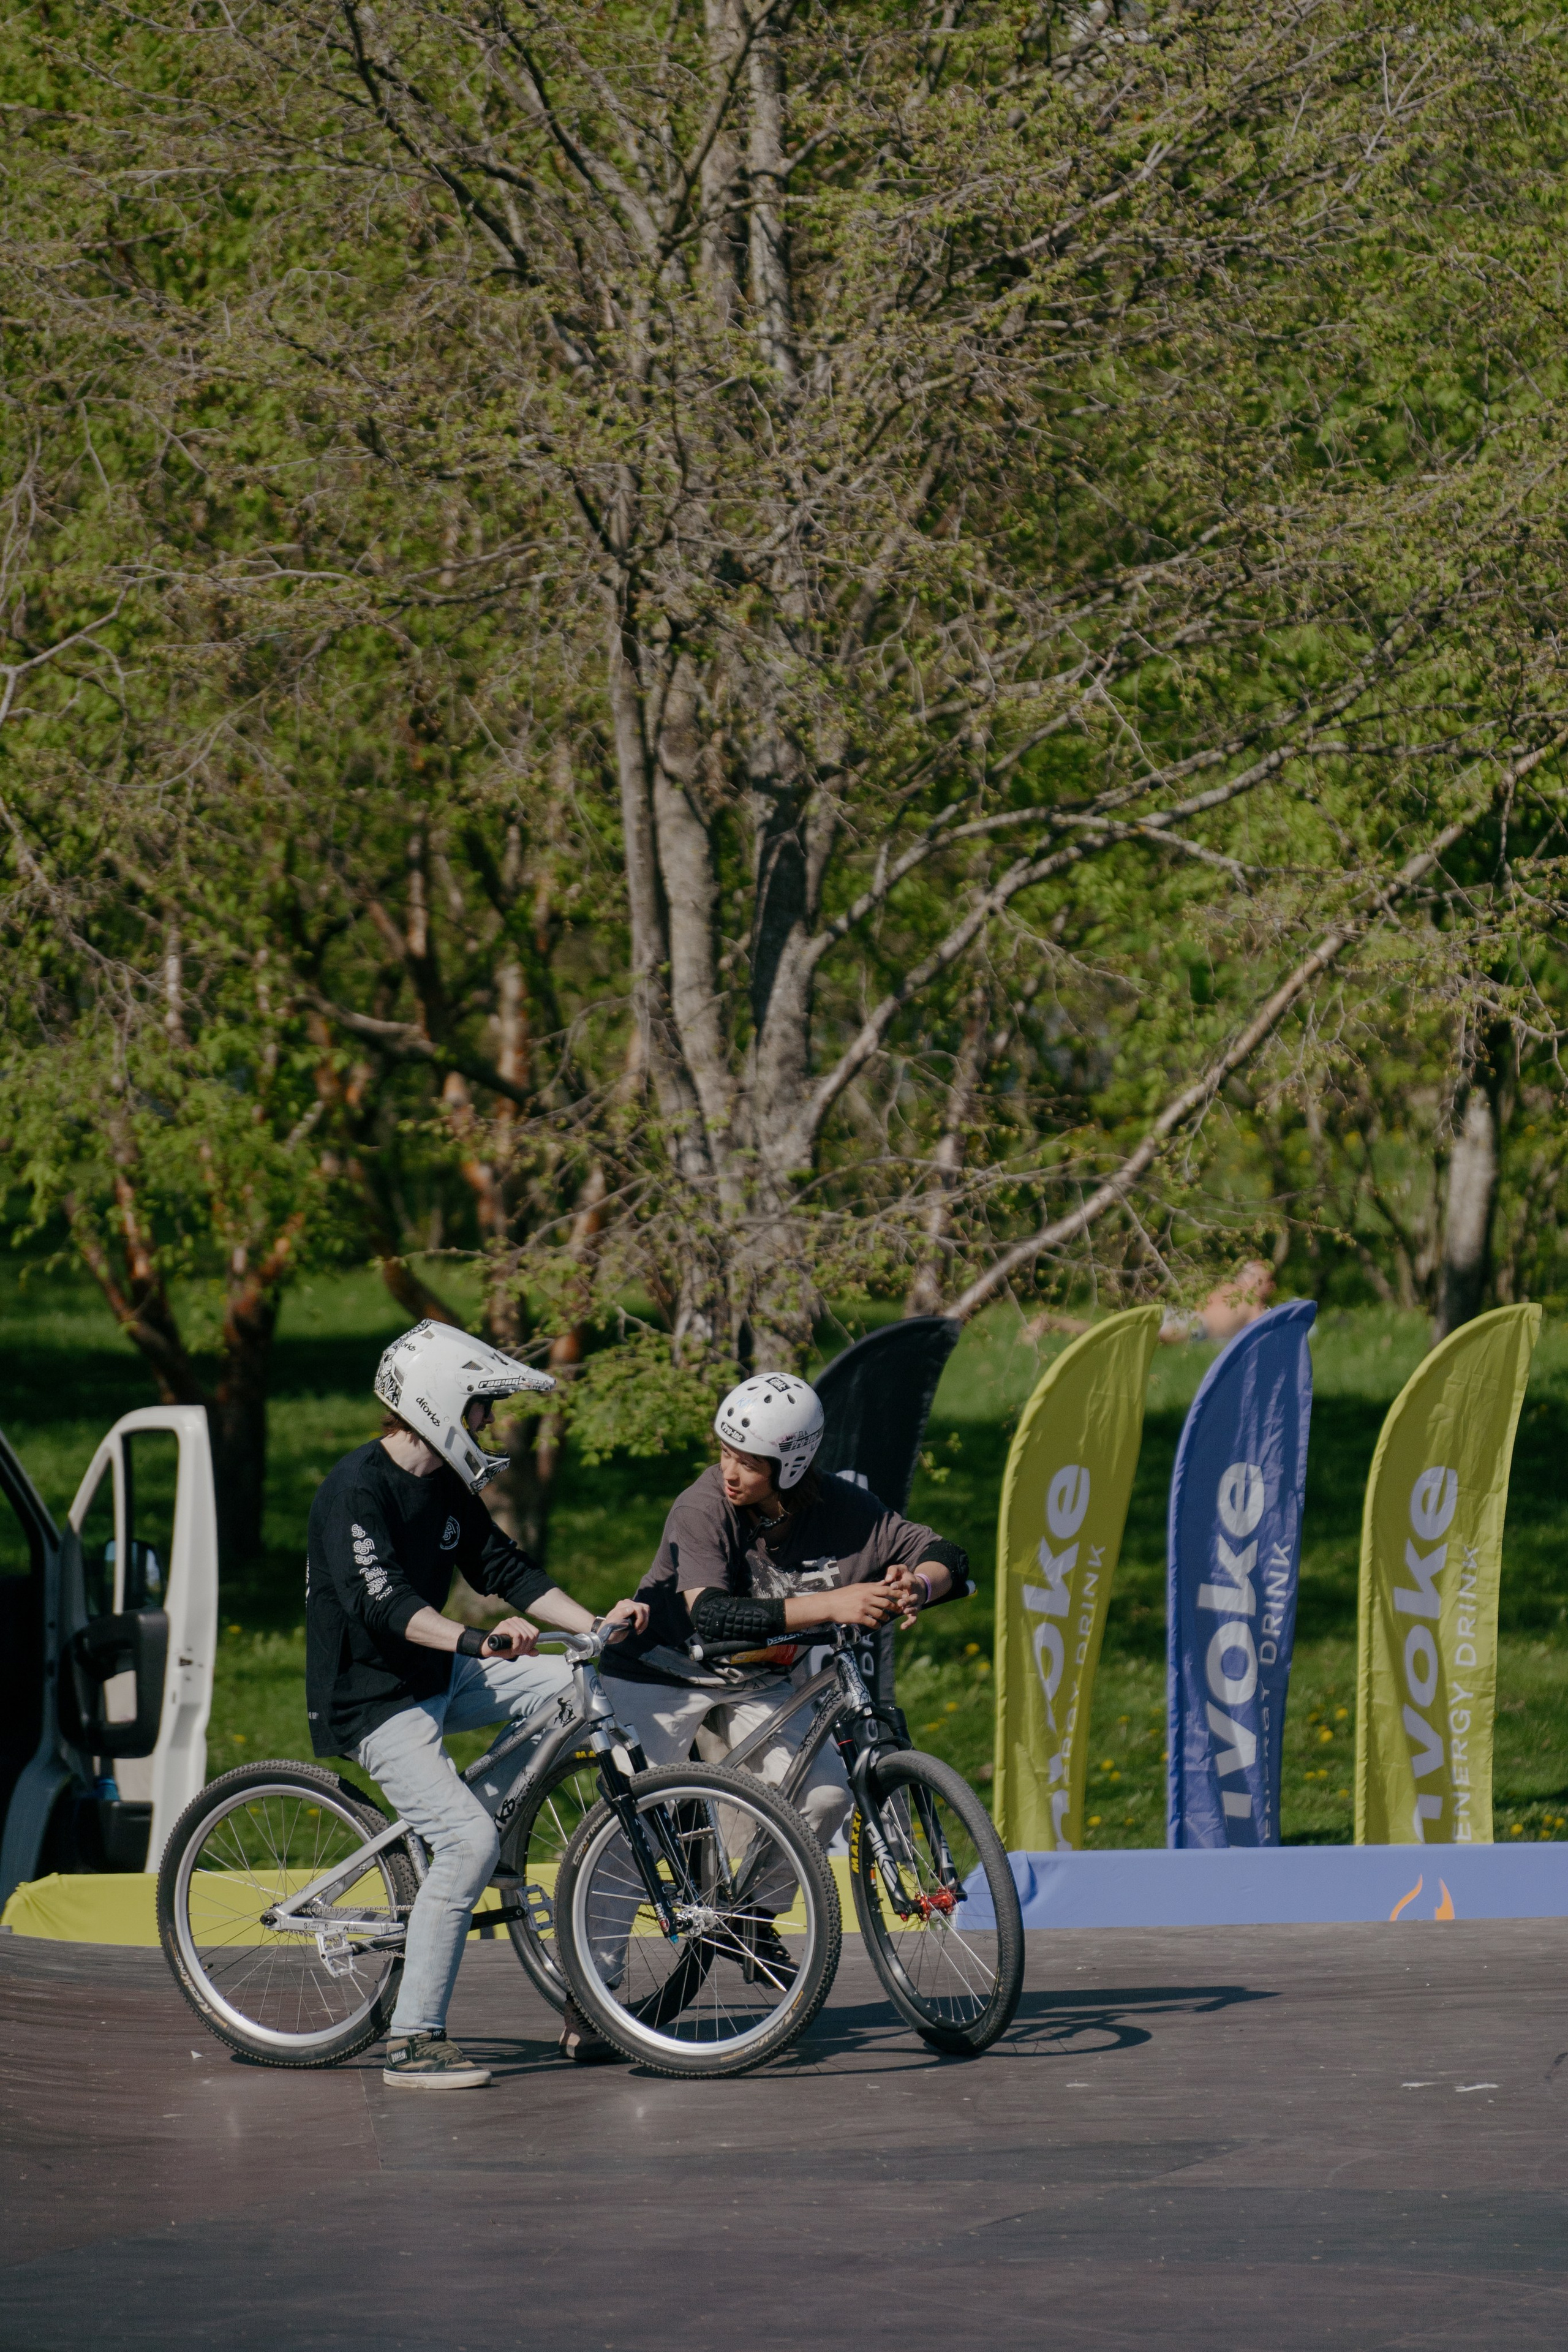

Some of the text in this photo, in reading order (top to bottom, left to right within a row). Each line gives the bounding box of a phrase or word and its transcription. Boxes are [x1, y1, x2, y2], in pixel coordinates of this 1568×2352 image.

[416, 1397, 440, 1427] dforks
[722, 1423, 744, 1442] Pro-tec
[1076, 1544, 1106, 1665] DRINK
[1260, 1542, 1291, 1665] DRINK
[1448, 1545, 1480, 1842] ENERGY DRINK
[851, 1809, 862, 1874] MAXXI
